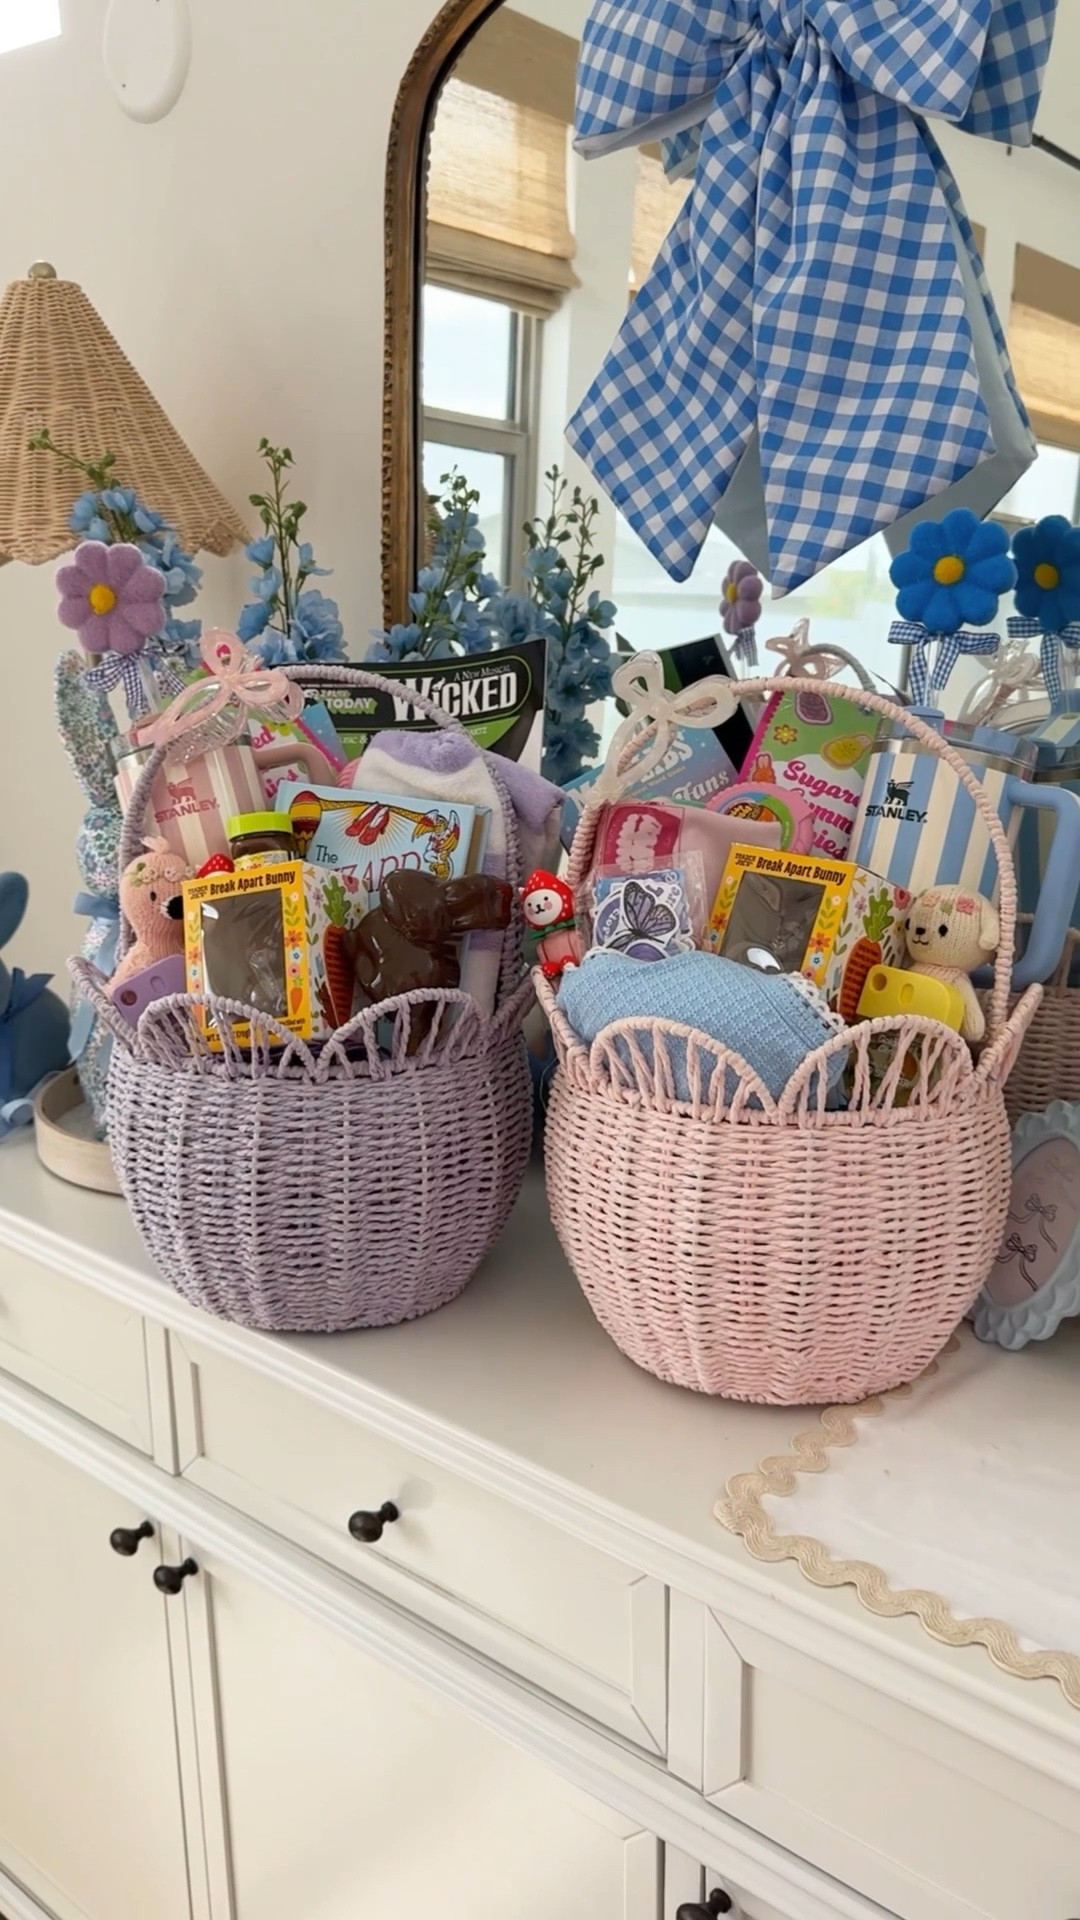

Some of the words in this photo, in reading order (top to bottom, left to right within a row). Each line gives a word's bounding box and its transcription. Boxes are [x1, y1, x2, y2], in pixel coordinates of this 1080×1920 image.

[326, 697, 373, 712] TODAY
[672, 770, 729, 801] Fans
[154, 798, 218, 823] STANLEY
[865, 805, 928, 823] STANLEY
[316, 844, 338, 863] The
[210, 880, 236, 896] Break
[237, 875, 263, 891] Apart
[265, 871, 296, 885] Bunny
[756, 857, 785, 873] Break
[784, 861, 812, 877] Apart
[813, 866, 847, 886] Bunny
